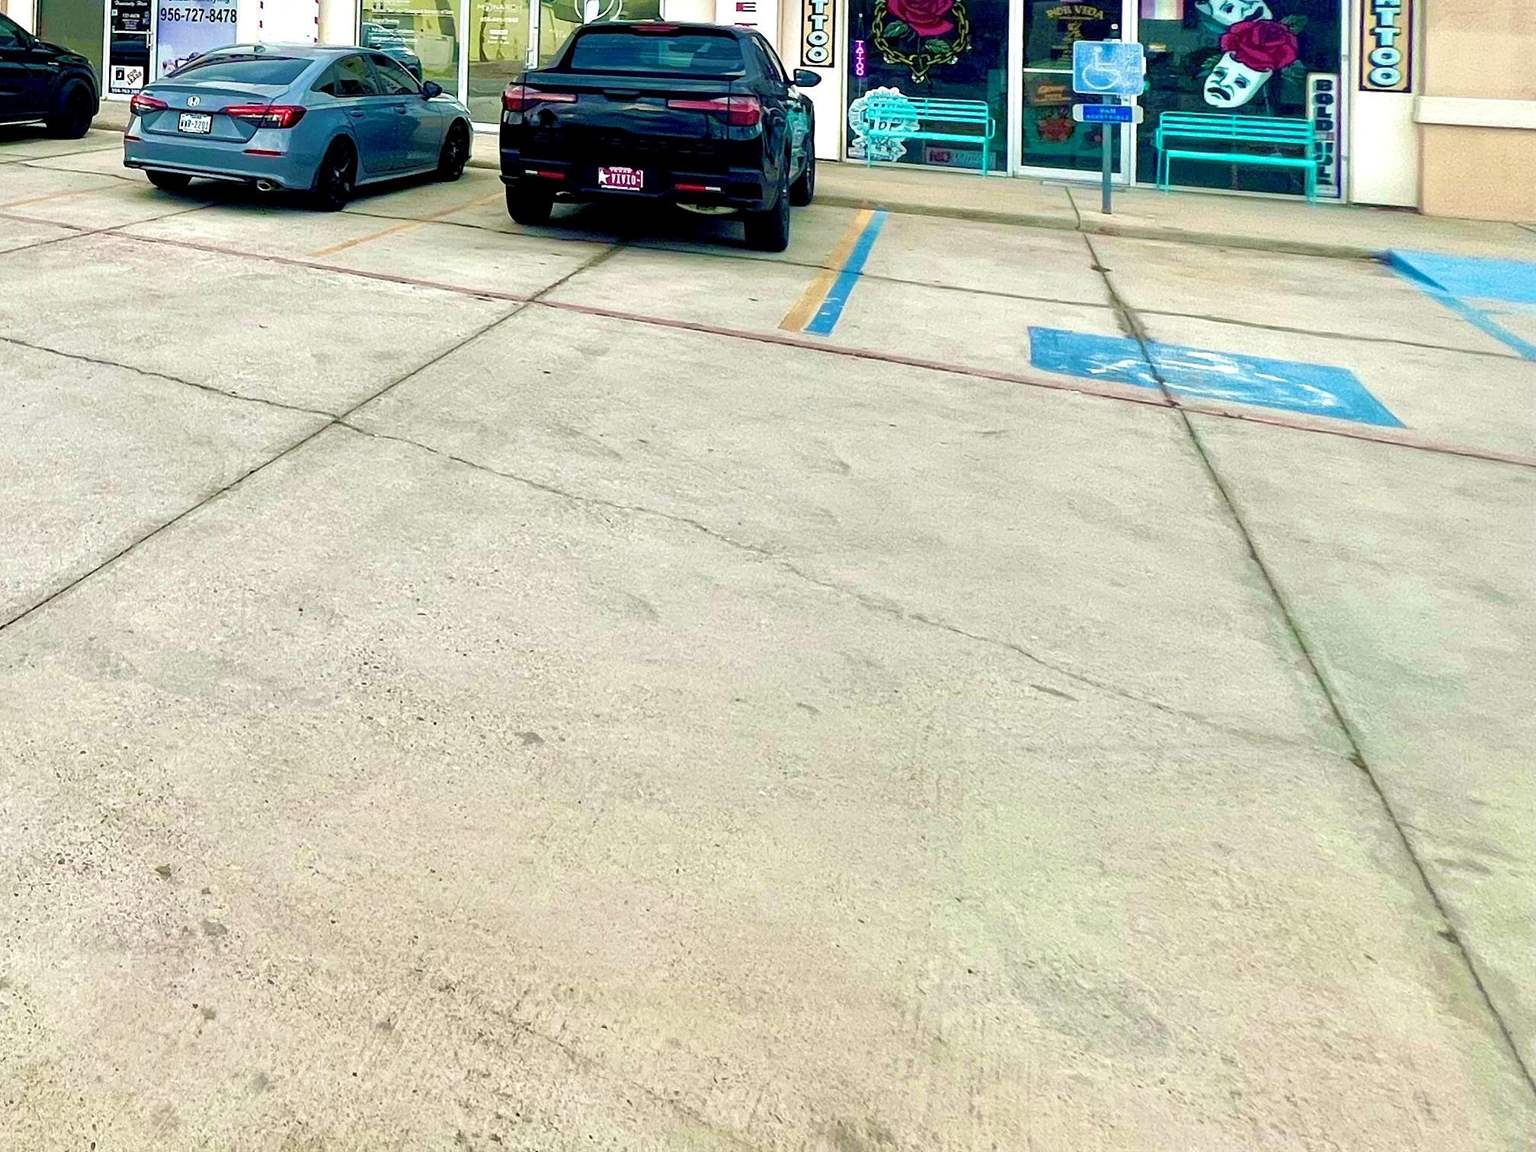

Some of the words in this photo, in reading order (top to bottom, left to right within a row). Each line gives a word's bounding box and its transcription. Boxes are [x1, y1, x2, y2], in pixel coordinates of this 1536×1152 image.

[160, 8, 237, 24] 956-727-8478
[1074, 5, 1104, 20] VIDA
[855, 39, 864, 77] TATTOO
[1315, 79, 1333, 131] BOLD
